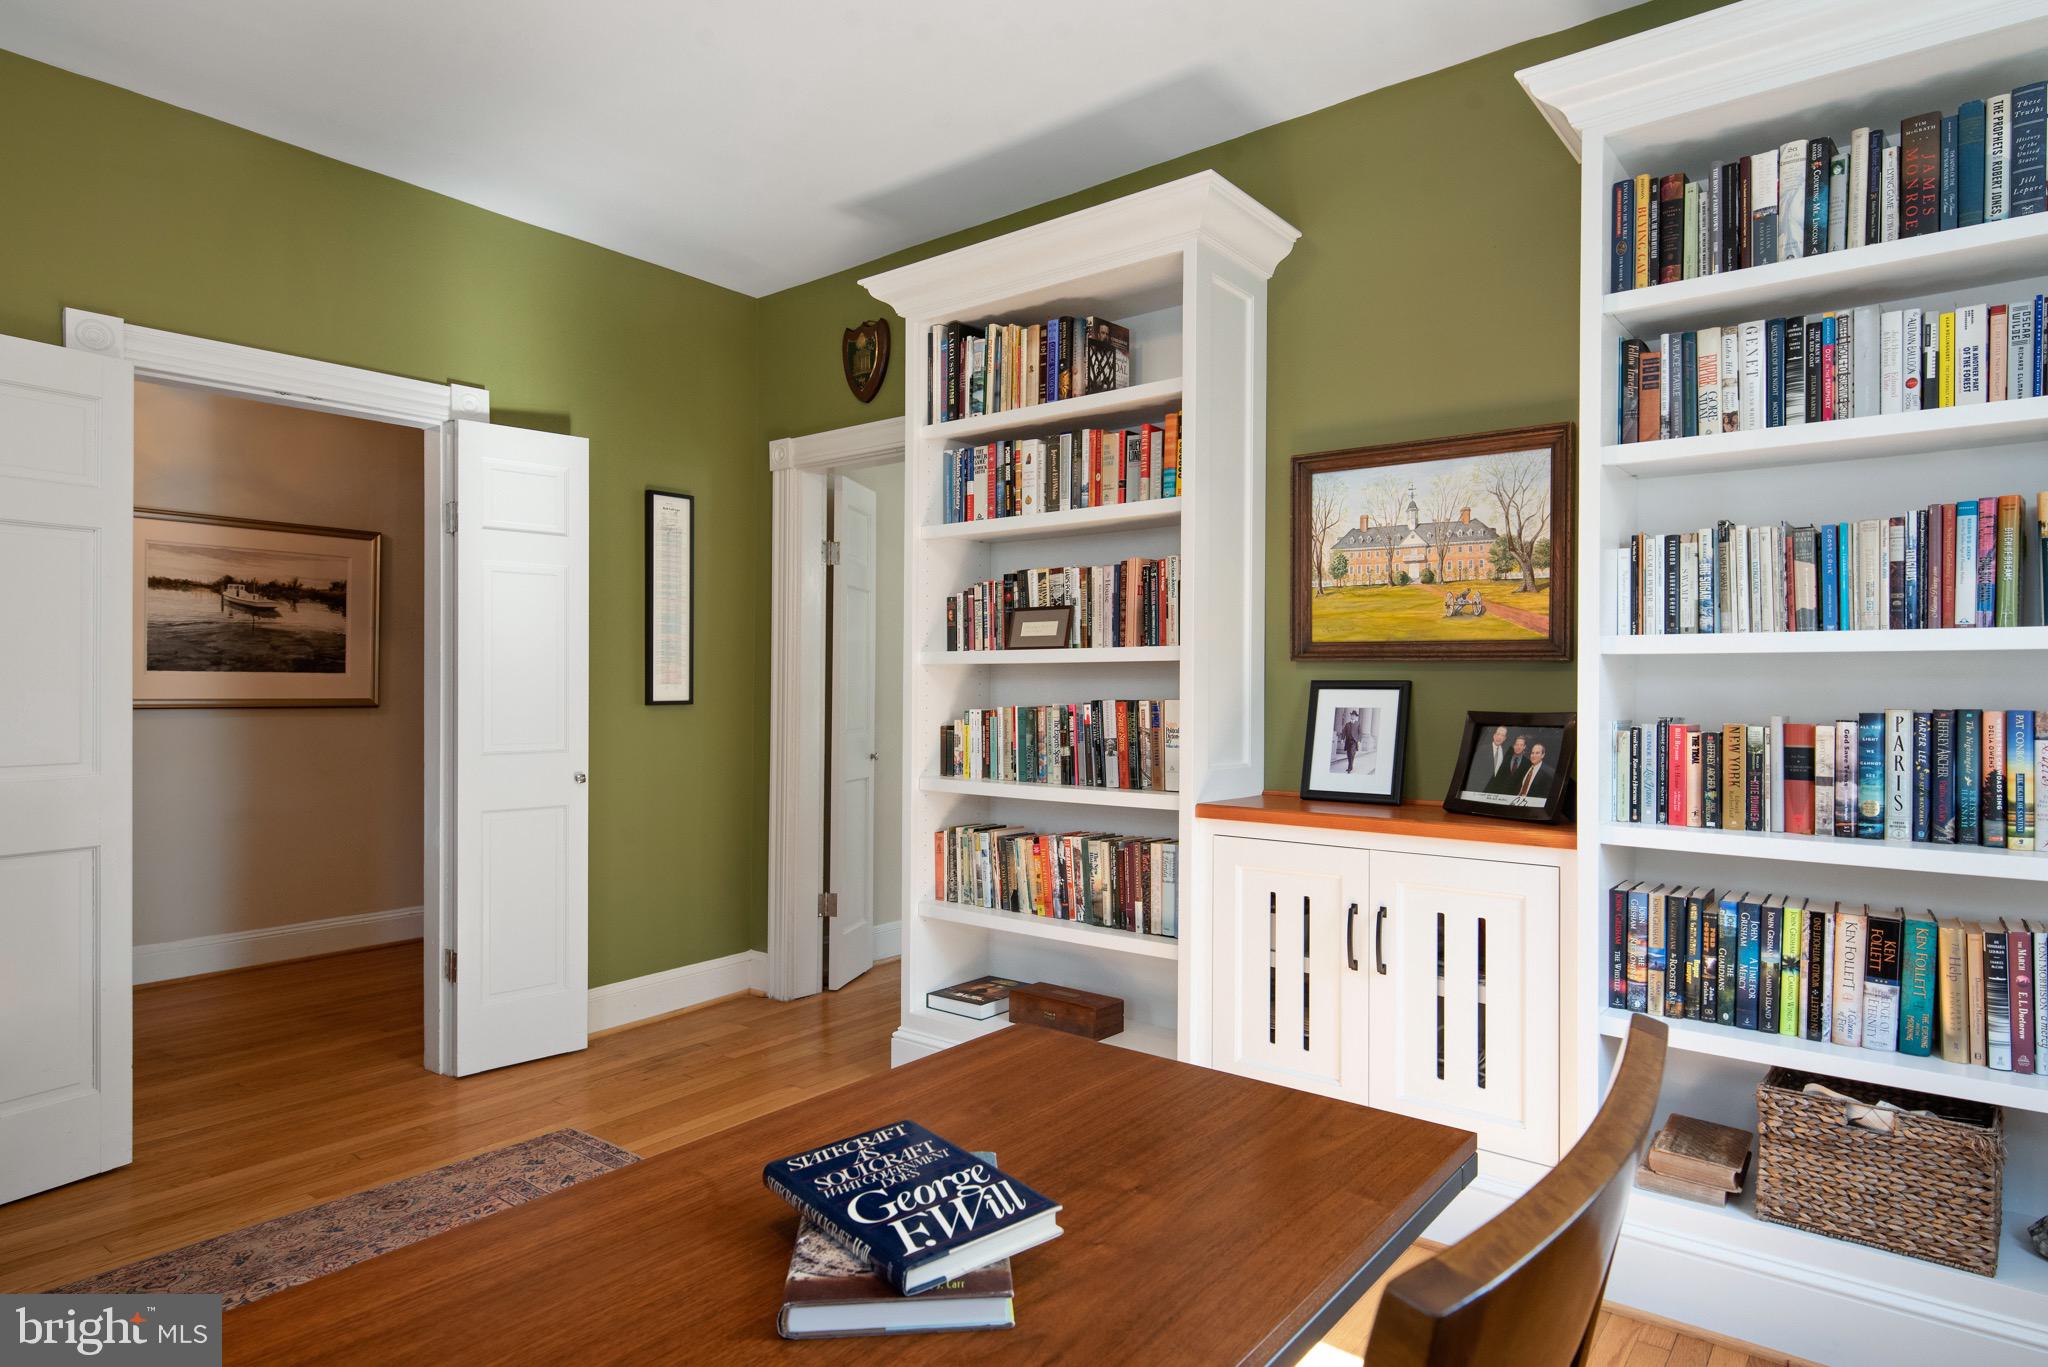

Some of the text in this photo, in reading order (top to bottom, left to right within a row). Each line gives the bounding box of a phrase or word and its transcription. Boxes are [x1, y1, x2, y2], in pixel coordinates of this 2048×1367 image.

[2014, 107, 2043, 118] Truths
[2016, 98, 2040, 108] These
[1915, 120, 1927, 128] TIM
[1990, 100, 2003, 217] THE PROPHETS ROBERT JONES,
[2016, 148, 2040, 157] United
[2018, 156, 2038, 164] States
[1905, 146, 1919, 231] MONROE
[1921, 153, 1936, 216] JAMES
[2013, 184, 2042, 195] Lepore
[2019, 176, 2035, 185] Jill
[1637, 206, 1648, 276] BUYING GAY
[1812, 218, 1821, 244] LINCOLN
[2011, 312, 2021, 341] WILDE
[2022, 311, 2032, 339] OSCAR
[1726, 338, 1735, 375] Golden Hill
[1745, 326, 1759, 378] GENET
[1627, 344, 1640, 399] Fellow Travelers
[1672, 344, 1681, 397] PLACE TABLE
[1698, 353, 1718, 387] EMPIRE
[1963, 347, 1971, 393] OF THE FOREST
[1771, 378, 1779, 396] NIGHT
[1699, 391, 1709, 424] VIDAL
[1707, 391, 1719, 422] GORE
[2003, 527, 2014, 546] DITCH
[1104, 579, 1112, 602] House
[1699, 563, 1713, 600] BIG SUGAR
[2016, 714, 2025, 730] PAT
[1053, 729, 1061, 749] Experts
[1673, 740, 1681, 761] Bryson
[1691, 735, 1700, 765] THE TRIAL
[1918, 716, 1927, 763] HARPER LEE
[1935, 717, 1950, 778] JEFFREY ARCHER
[1963, 721, 1975, 774] The Nightingale
[1706, 742, 1716, 790] JEFFREY ARCHER
[1729, 725, 1742, 788] NEW YORK
[1893, 715, 1905, 812] PARIS
[1740, 912, 1751, 947] GRISHAM
[1750, 920, 1760, 941] JOHN
[1790, 911, 1798, 928] JOHN
[1630, 937, 1639, 980] RECKONING
[1765, 911, 1776, 1019] JOHN GRISHAM ISLAND
[1842, 921, 1858, 993] KEN FOLLETT
[1869, 930, 1883, 974] FOLLETT
[1884, 942, 1896, 965] KEN
[1912, 927, 1929, 999] KEN FOLLETT
[2018, 949, 2028, 971] MARCH
[1669, 958, 1678, 990] ROOSTER
[1685, 961, 1693, 985] Lawyer
[1718, 947, 1727, 991] GUARDIANS
[1727, 963, 1735, 977] THE
[1739, 963, 1749, 991] MERCY
[1748, 965, 1759, 999] TIME FOR
[1811, 917, 1821, 1022] FOLLETT WORLD WITHOUT END
[1947, 956, 1962, 982] Help
[2019, 991, 2028, 999] E.
[2039, 963, 2048, 1010] MORRISON
[1847, 1016, 1857, 1042] Column
[1867, 1000, 1880, 1041] ETERNITY
[1880, 997, 1891, 1035] EDGE OF
[2018, 1007, 2028, 1041] Doctorow
[1920, 1026, 1929, 1049] EVENING
[785, 1123, 908, 1172] STATECRAFT
[853, 1147, 881, 1165] AS
[813, 1140, 938, 1191] SOULCRAFT
[823, 1147, 951, 1199] WHAT GOVERNMENT
[880, 1170, 921, 1189] DOES
[847, 1164, 991, 1225] George
[888, 1182, 1027, 1257] F. Will
[852, 1236, 871, 1264] Will
[946, 1280, 965, 1289] Carr
